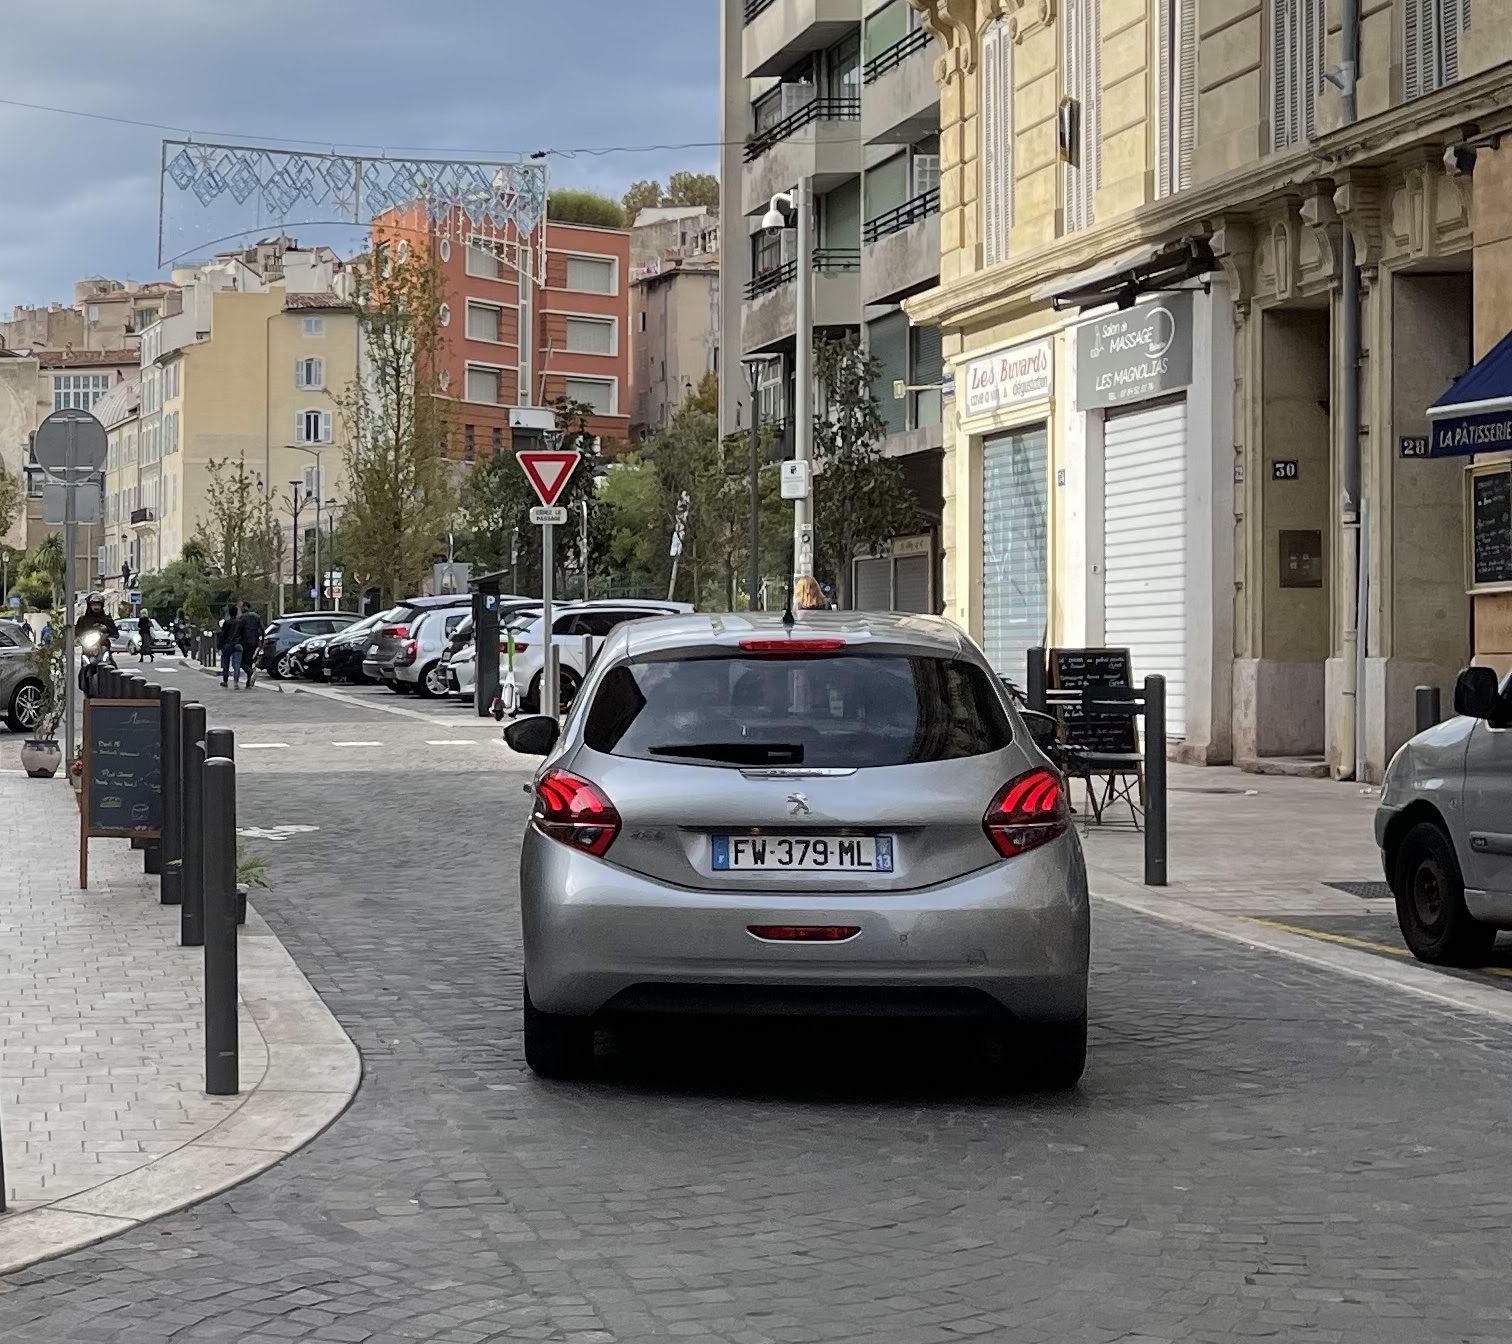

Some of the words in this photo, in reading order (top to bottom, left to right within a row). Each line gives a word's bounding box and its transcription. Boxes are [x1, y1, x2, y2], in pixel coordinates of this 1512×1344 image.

[1109, 326, 1154, 354] MASSAGE
[971, 367, 995, 390] Les
[999, 349, 1047, 383] Buvards
[1095, 372, 1112, 391] LES
[1113, 357, 1169, 386] MAGNOLIAS
[1403, 439, 1425, 455] 28
[1439, 429, 1453, 448] LA
[1454, 420, 1512, 447] PÂTISSERIE
[1275, 463, 1296, 477] 30
